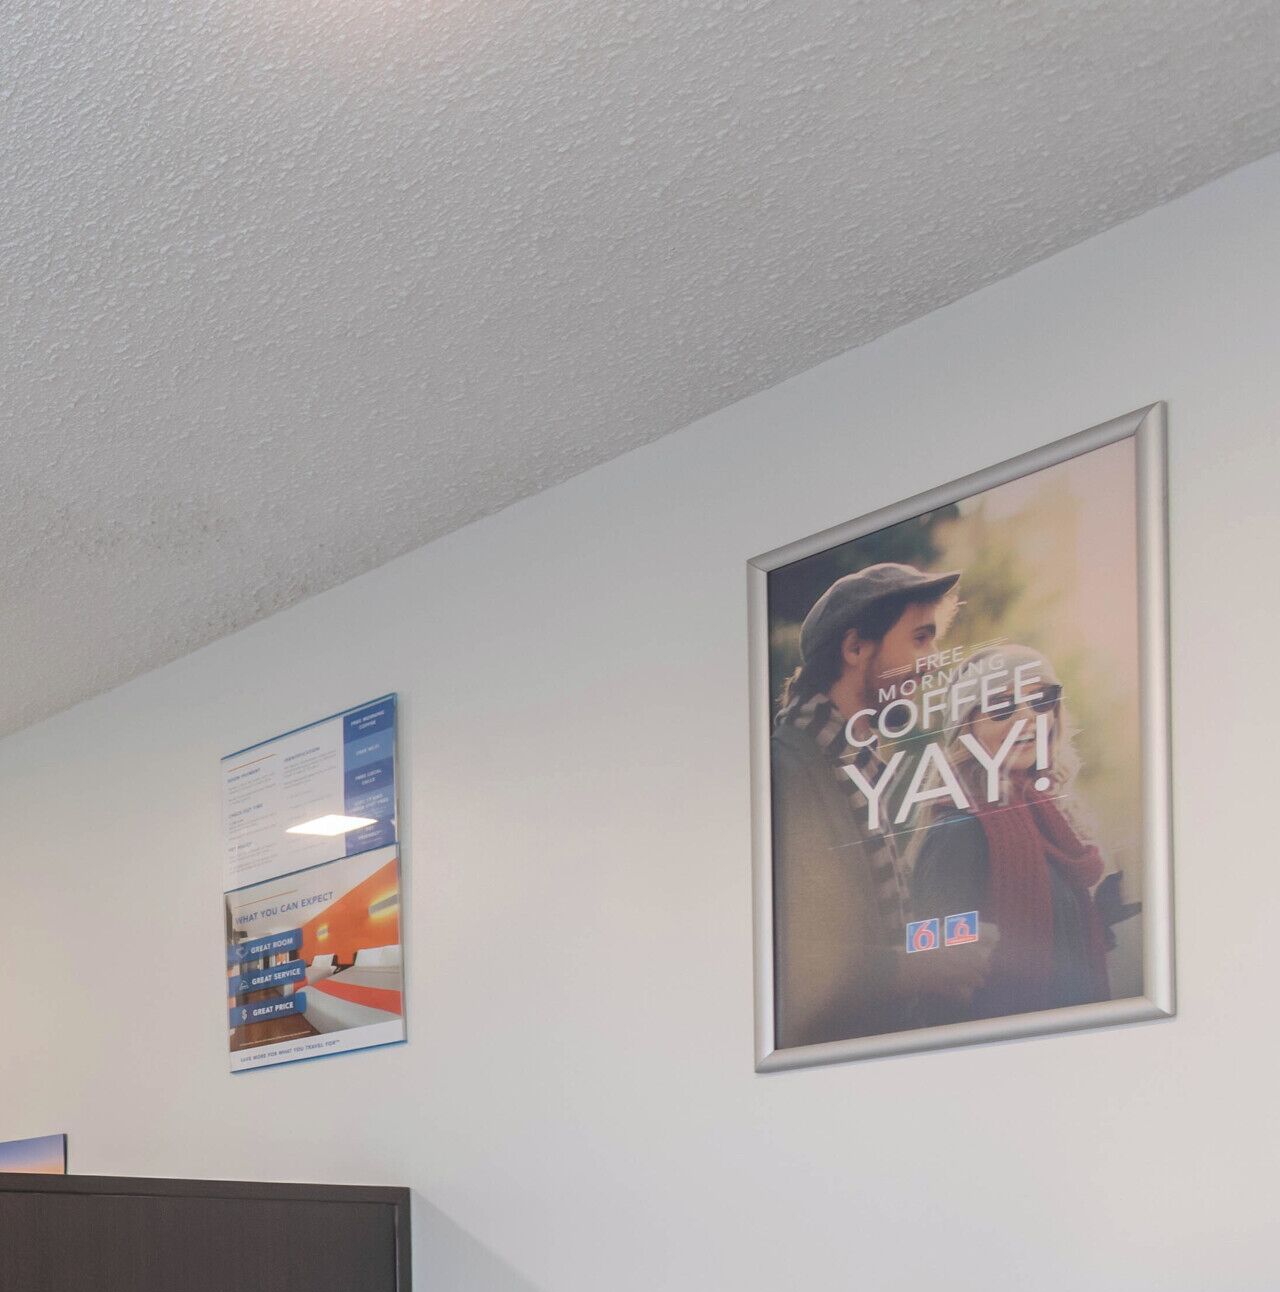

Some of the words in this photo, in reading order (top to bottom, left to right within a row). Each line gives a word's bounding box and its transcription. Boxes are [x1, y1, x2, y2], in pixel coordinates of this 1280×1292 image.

[915, 646, 964, 674] FREE
[878, 653, 1005, 703] MORNING
[844, 660, 1044, 748] COFFEE
[841, 713, 1051, 831] YAY!
[235, 911, 258, 926] WHAT
[260, 907, 278, 918] YOU
[280, 902, 298, 914] CAN
[301, 891, 334, 908] EXPECT
[250, 943, 271, 954] GREAT
[272, 938, 293, 950] ROOM
[251, 975, 272, 986] GREAT
[273, 968, 301, 981] SERVICE
[252, 1006, 273, 1017] GREAT
[275, 1002, 294, 1013] PRICE
